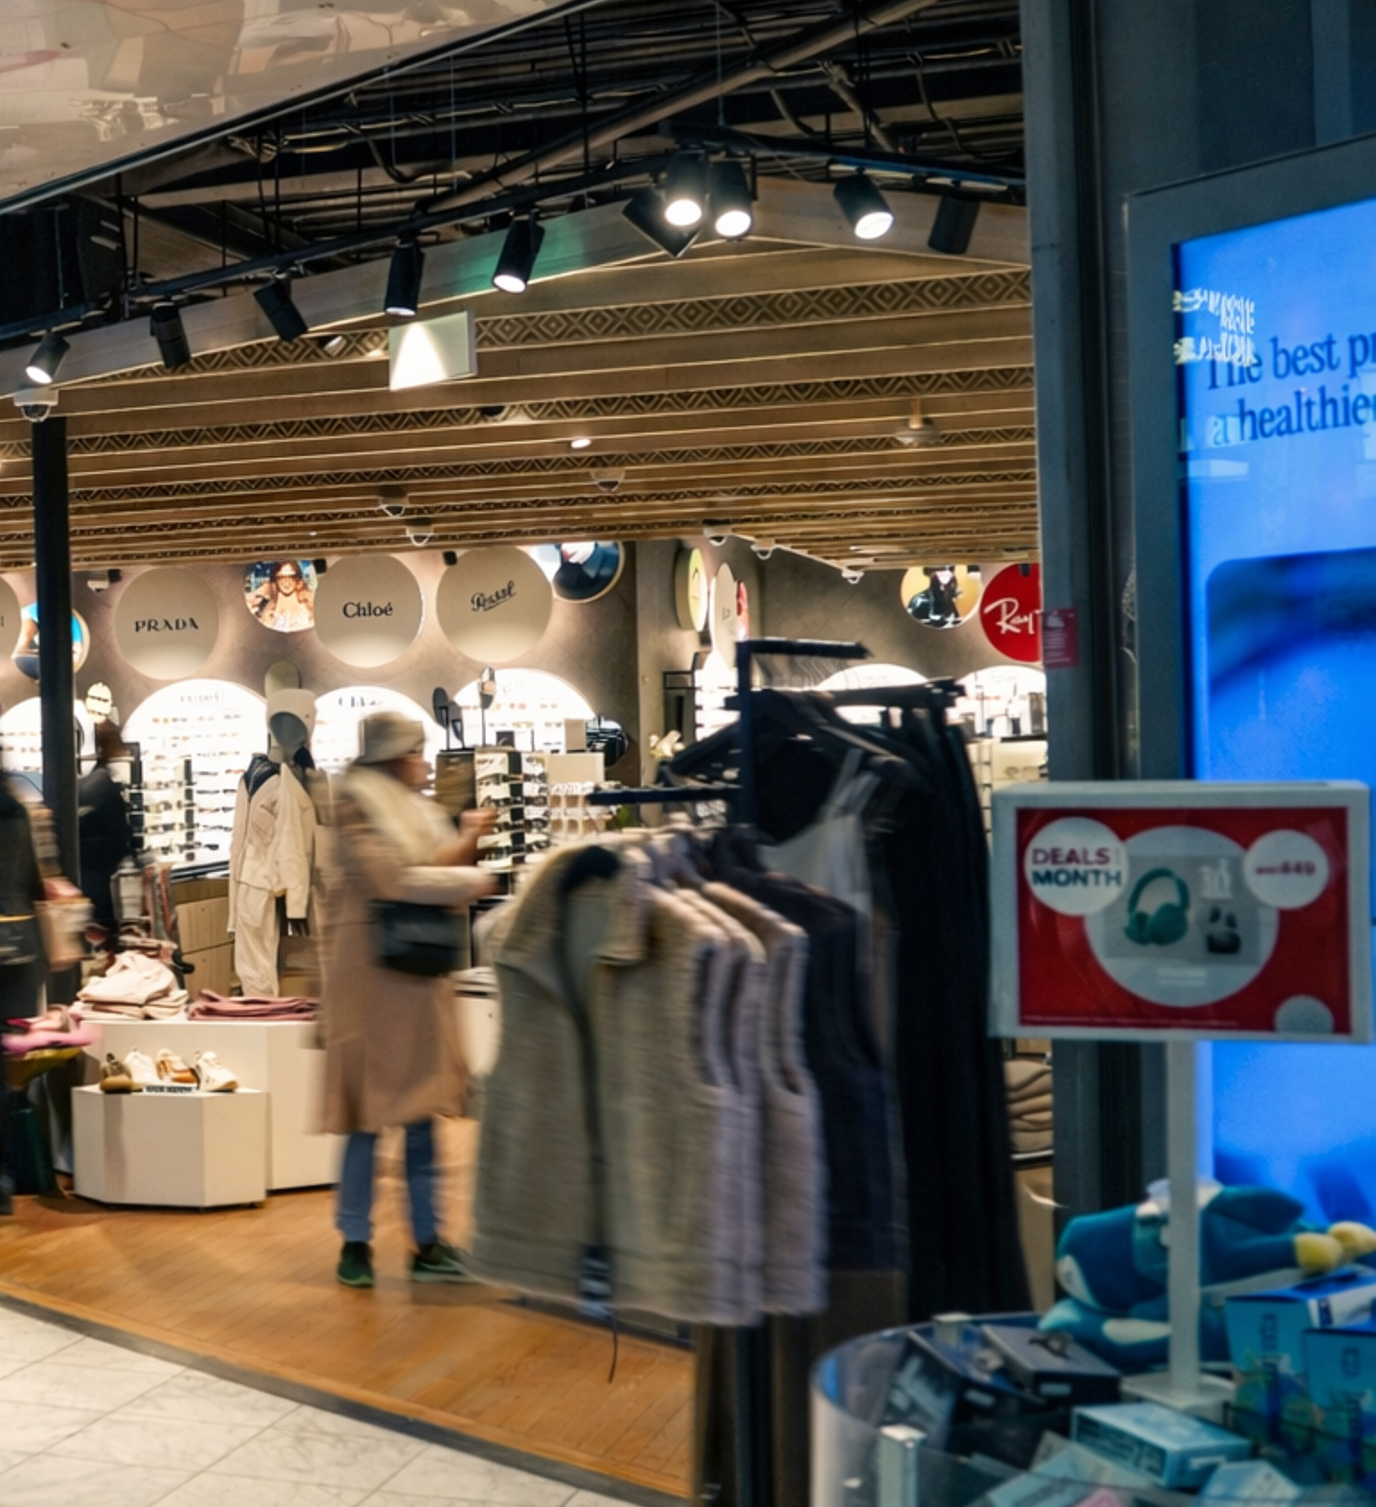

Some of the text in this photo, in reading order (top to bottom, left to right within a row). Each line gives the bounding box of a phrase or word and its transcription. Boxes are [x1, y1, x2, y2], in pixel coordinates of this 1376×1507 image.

[1270, 333, 1341, 380] best
[342, 601, 394, 618] Chloé
[134, 617, 199, 632] PRADA
[1032, 847, 1111, 866] DEALS
[1031, 868, 1122, 888] MONTH
